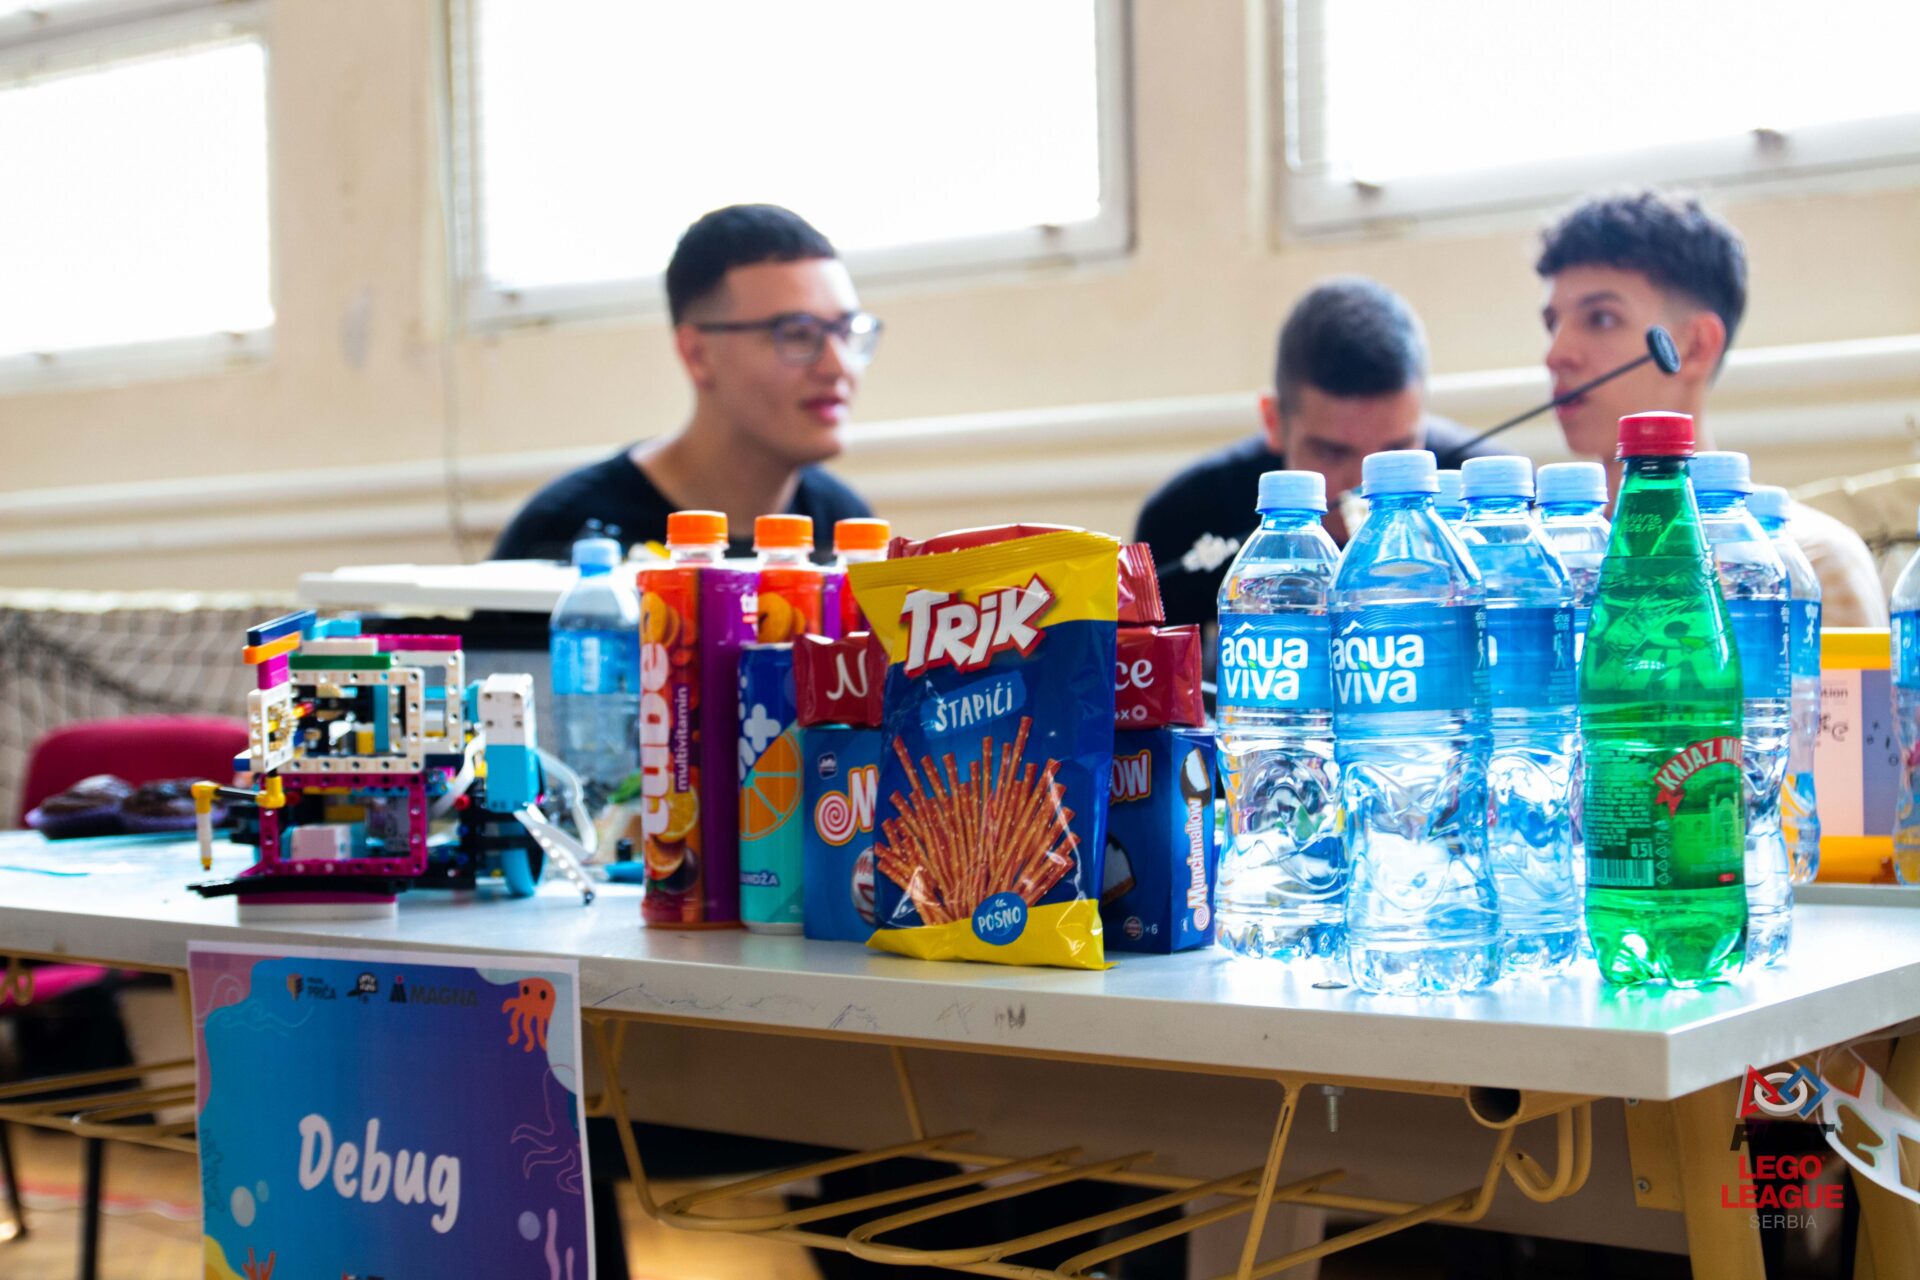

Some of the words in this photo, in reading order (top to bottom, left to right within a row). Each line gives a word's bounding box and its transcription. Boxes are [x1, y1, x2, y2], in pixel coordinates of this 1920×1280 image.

[1222, 636, 1309, 669] aqua
[1332, 634, 1425, 670] aqua
[1224, 669, 1300, 701] viva
[1335, 669, 1418, 705] viva
[674, 686, 689, 791] multivitamin
[1657, 741, 1718, 791] KNJAZ
[1721, 738, 1742, 764] MIL
[1185, 797, 1210, 931] Munchmallow
[977, 905, 1022, 934] POSNO
[298, 1113, 460, 1233] Debug
